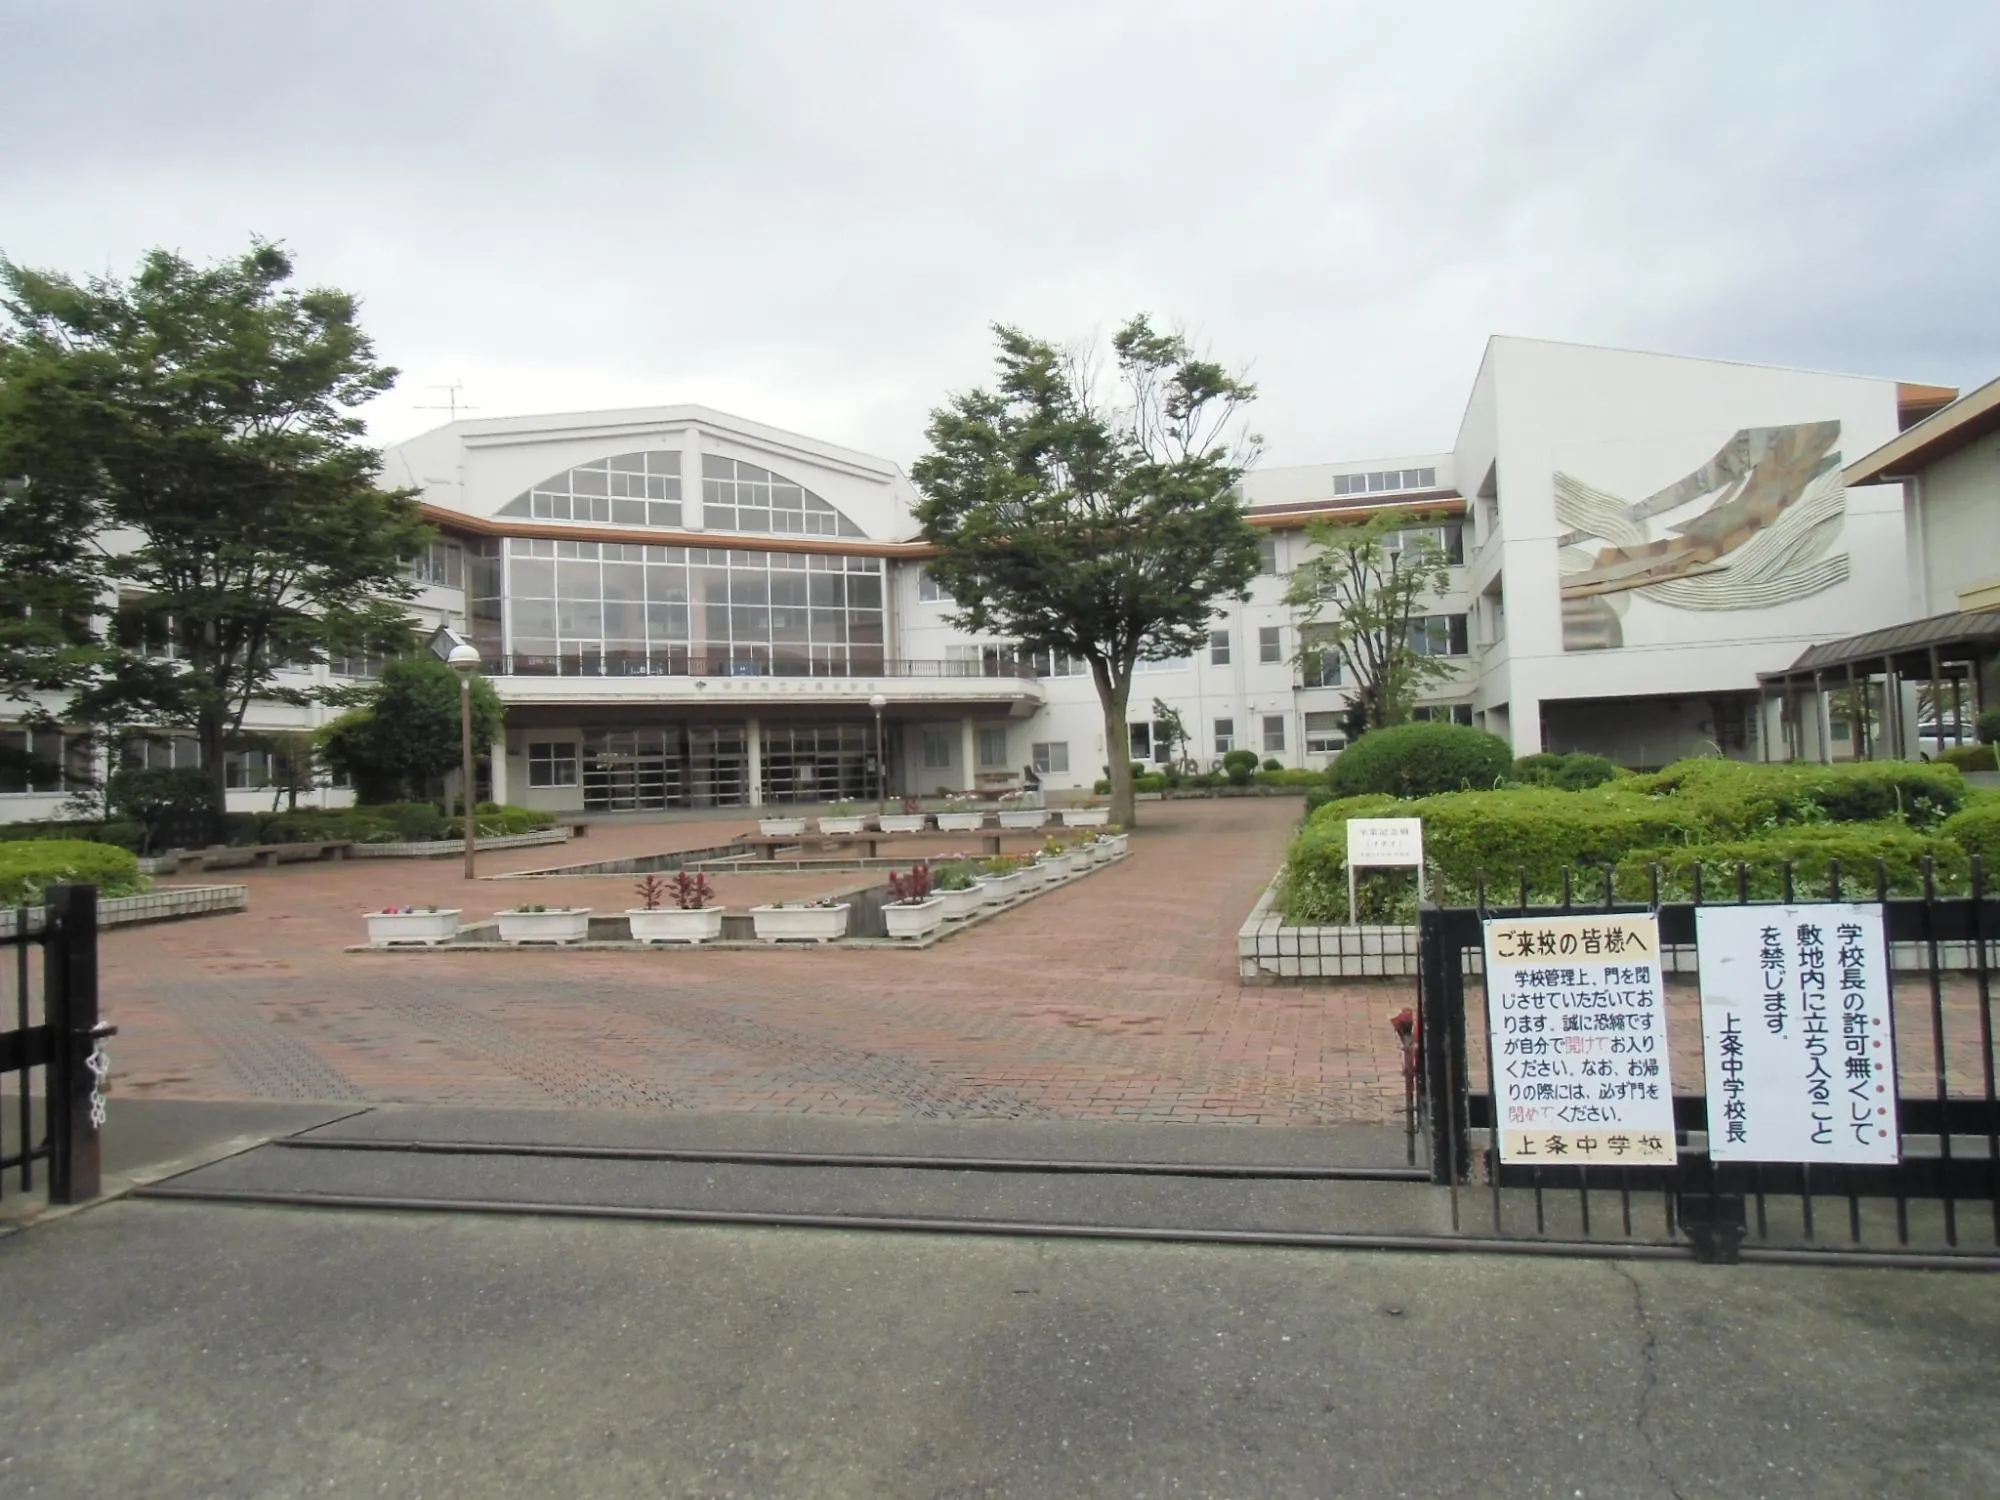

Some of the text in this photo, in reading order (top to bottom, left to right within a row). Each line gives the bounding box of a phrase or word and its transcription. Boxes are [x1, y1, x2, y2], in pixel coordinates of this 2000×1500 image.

[1497, 926, 1648, 957] ご来校の皆様へ
[1515, 966, 1650, 987] 学校管理上、門を閉
[1502, 989, 1653, 1009] じさせていただいてお
[1504, 1013, 1653, 1034] ります。誠に恐縮です
[1797, 923, 1832, 1144] 敷地内に立ち入ること
[1837, 923, 1873, 1145] 学校長の許可無くして
[1504, 1036, 1654, 1055] が自分で開けてお入り
[1506, 1060, 1659, 1078] ください。なお、お帰
[1720, 1012, 1747, 1143] 上条中学校長
[1509, 1083, 1659, 1101] りの際には、必ず門を
[1508, 1105, 1622, 1123] 閉めてください。
[1516, 1135, 1664, 1156] 上条中学校
